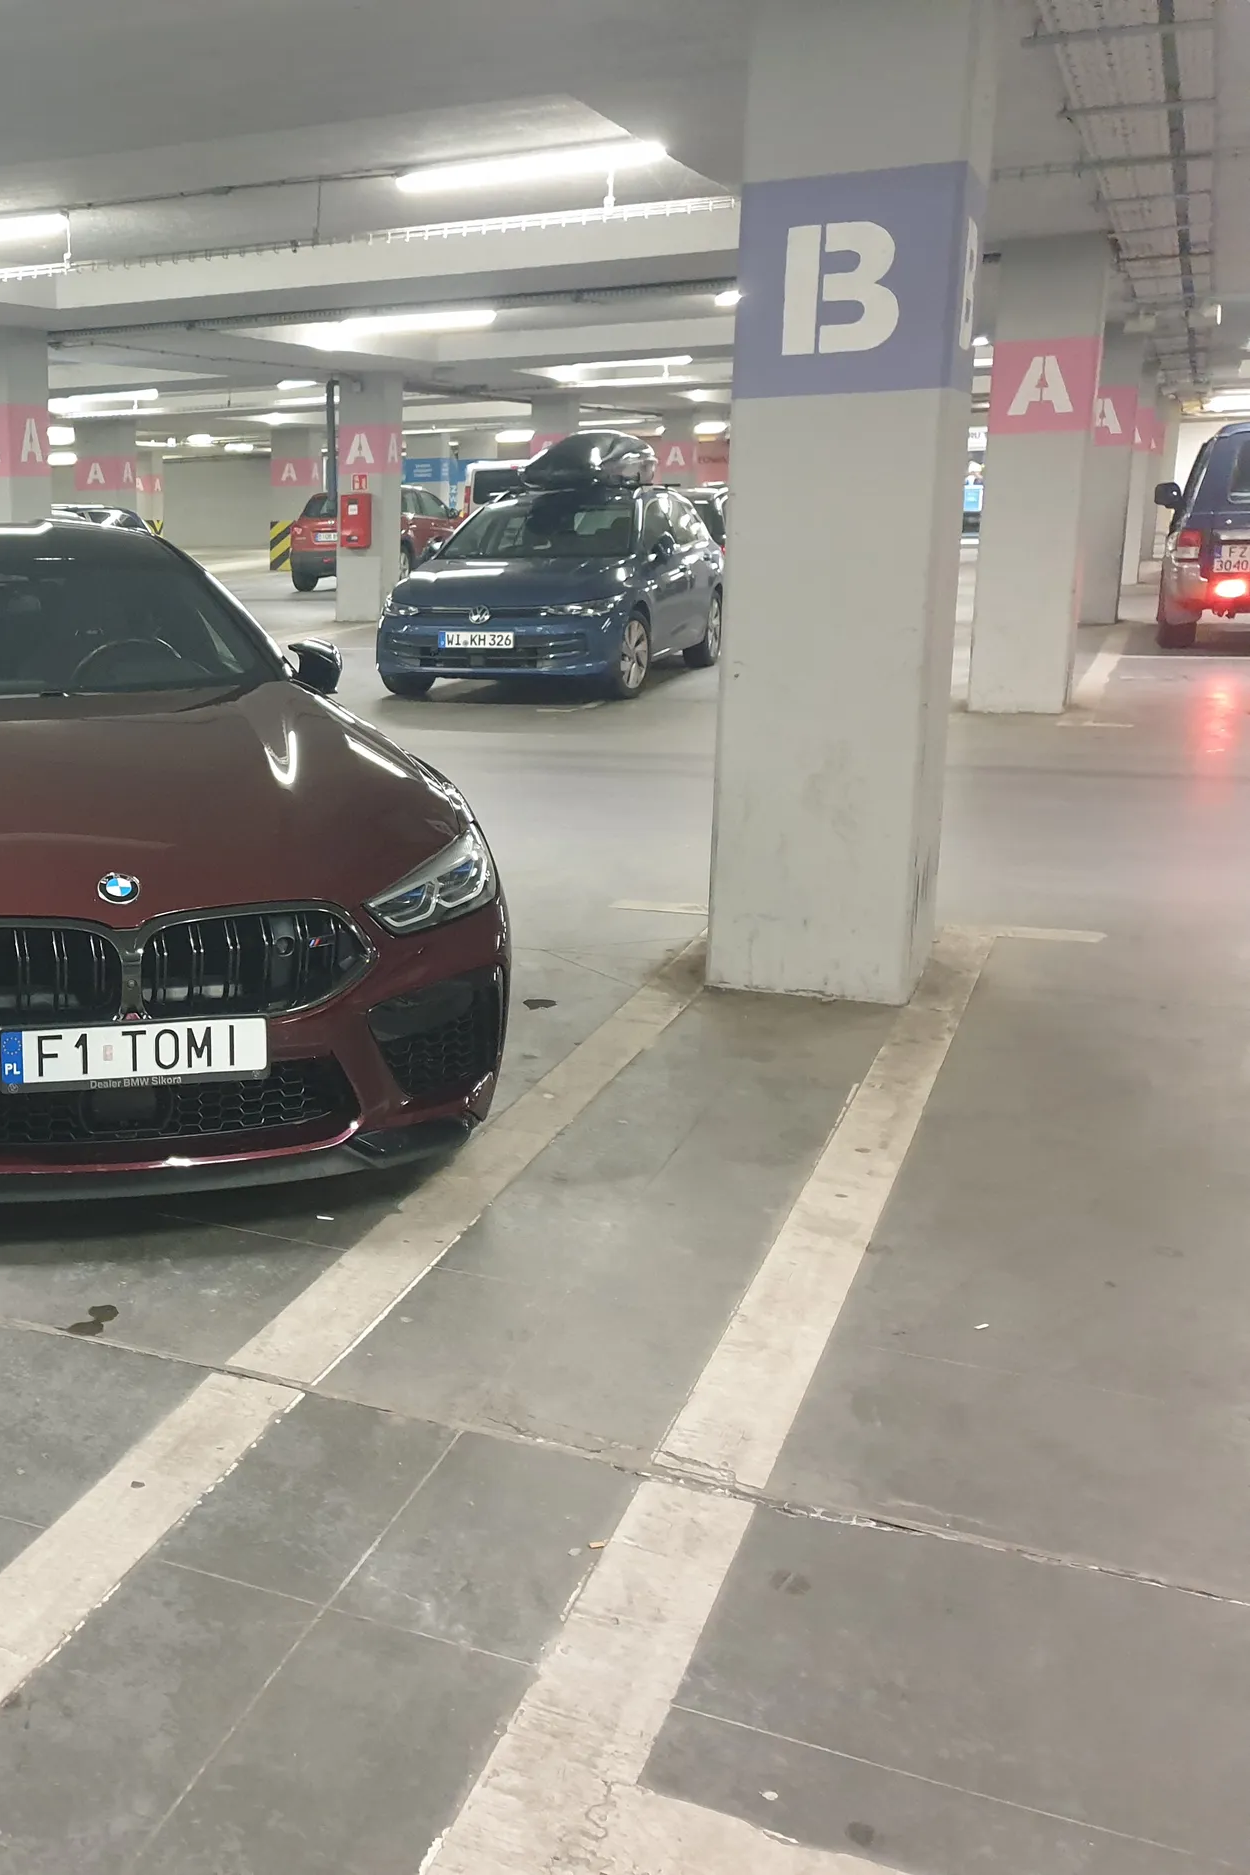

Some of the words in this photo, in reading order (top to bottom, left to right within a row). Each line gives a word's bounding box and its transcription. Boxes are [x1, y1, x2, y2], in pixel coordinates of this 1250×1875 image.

[782, 220, 900, 356] B
[1007, 355, 1074, 416] A
[1093, 397, 1123, 435] A
[21, 418, 43, 462] A
[345, 432, 375, 464] A
[386, 432, 399, 463] A
[665, 446, 686, 466] A
[87, 463, 105, 484] A
[122, 461, 134, 482] A
[281, 463, 298, 481] A
[311, 462, 321, 480] A
[154, 478, 161, 491] A
[1228, 545, 1248, 558] FZ
[1215, 559, 1249, 571] 3040
[447, 633, 461, 646] WI
[470, 633, 486, 646] KH
[489, 633, 512, 647] 326
[37, 1033, 88, 1077] F1
[122, 1025, 235, 1072] TOMI
[4, 1063, 21, 1076] PL
[90, 1077, 123, 1090] Dealer
[124, 1077, 150, 1088] BMW
[152, 1075, 183, 1086] Sikora
